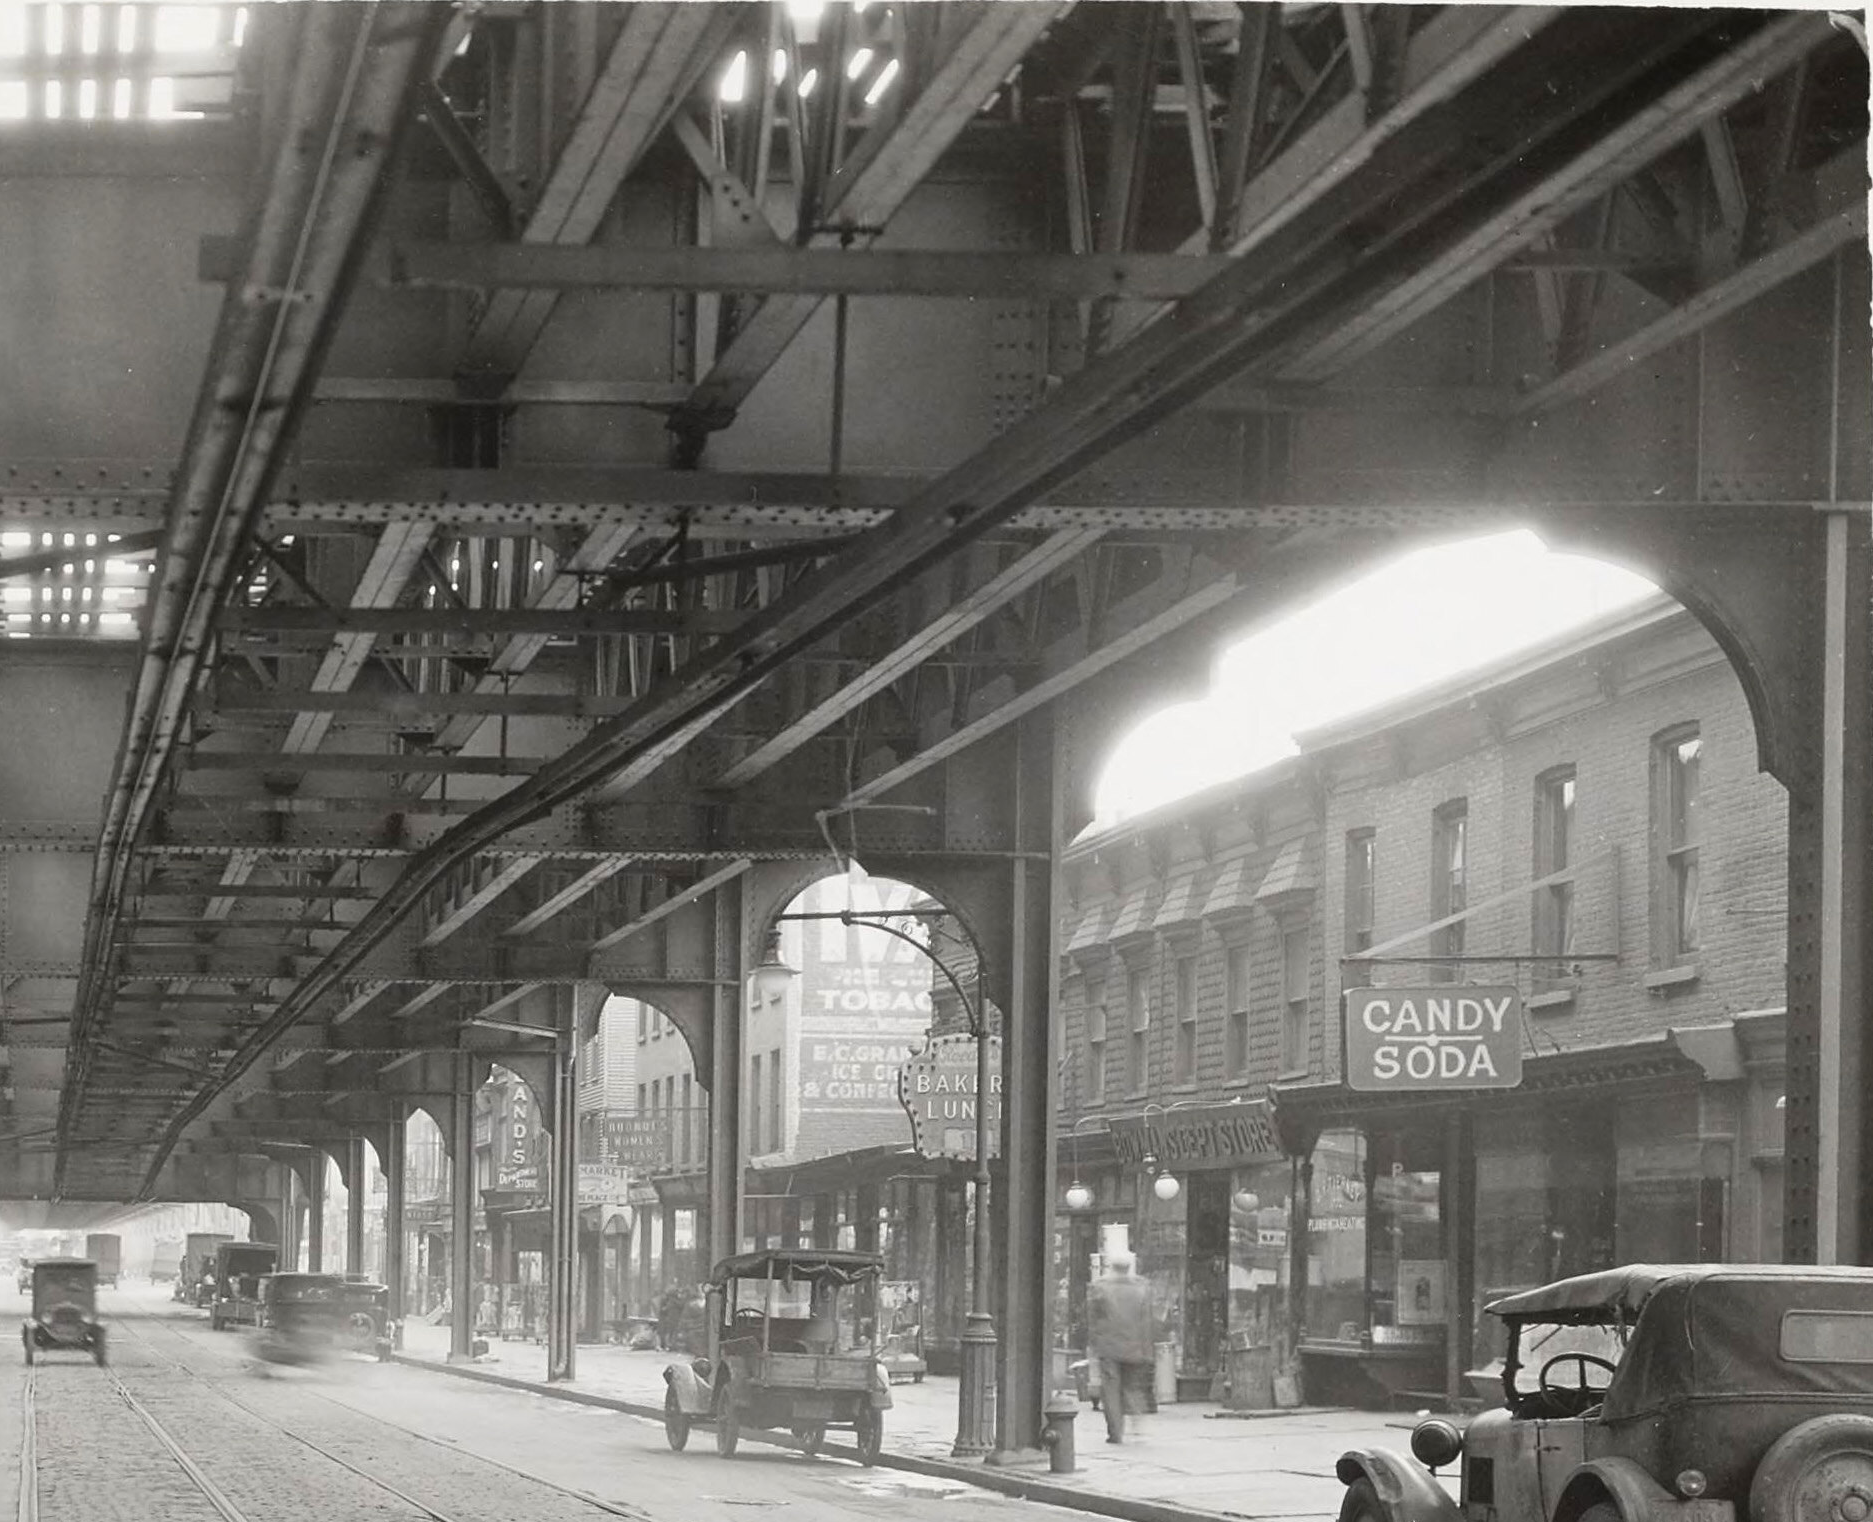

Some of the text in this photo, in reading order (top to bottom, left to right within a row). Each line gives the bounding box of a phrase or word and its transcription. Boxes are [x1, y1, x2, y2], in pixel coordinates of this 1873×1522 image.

[1363, 997, 1512, 1033] CANDY
[1373, 1044, 1498, 1079] SODA
[832, 1064, 861, 1080] ICE
[917, 1074, 1002, 1094] BAKR
[928, 1101, 1002, 1119] LUN
